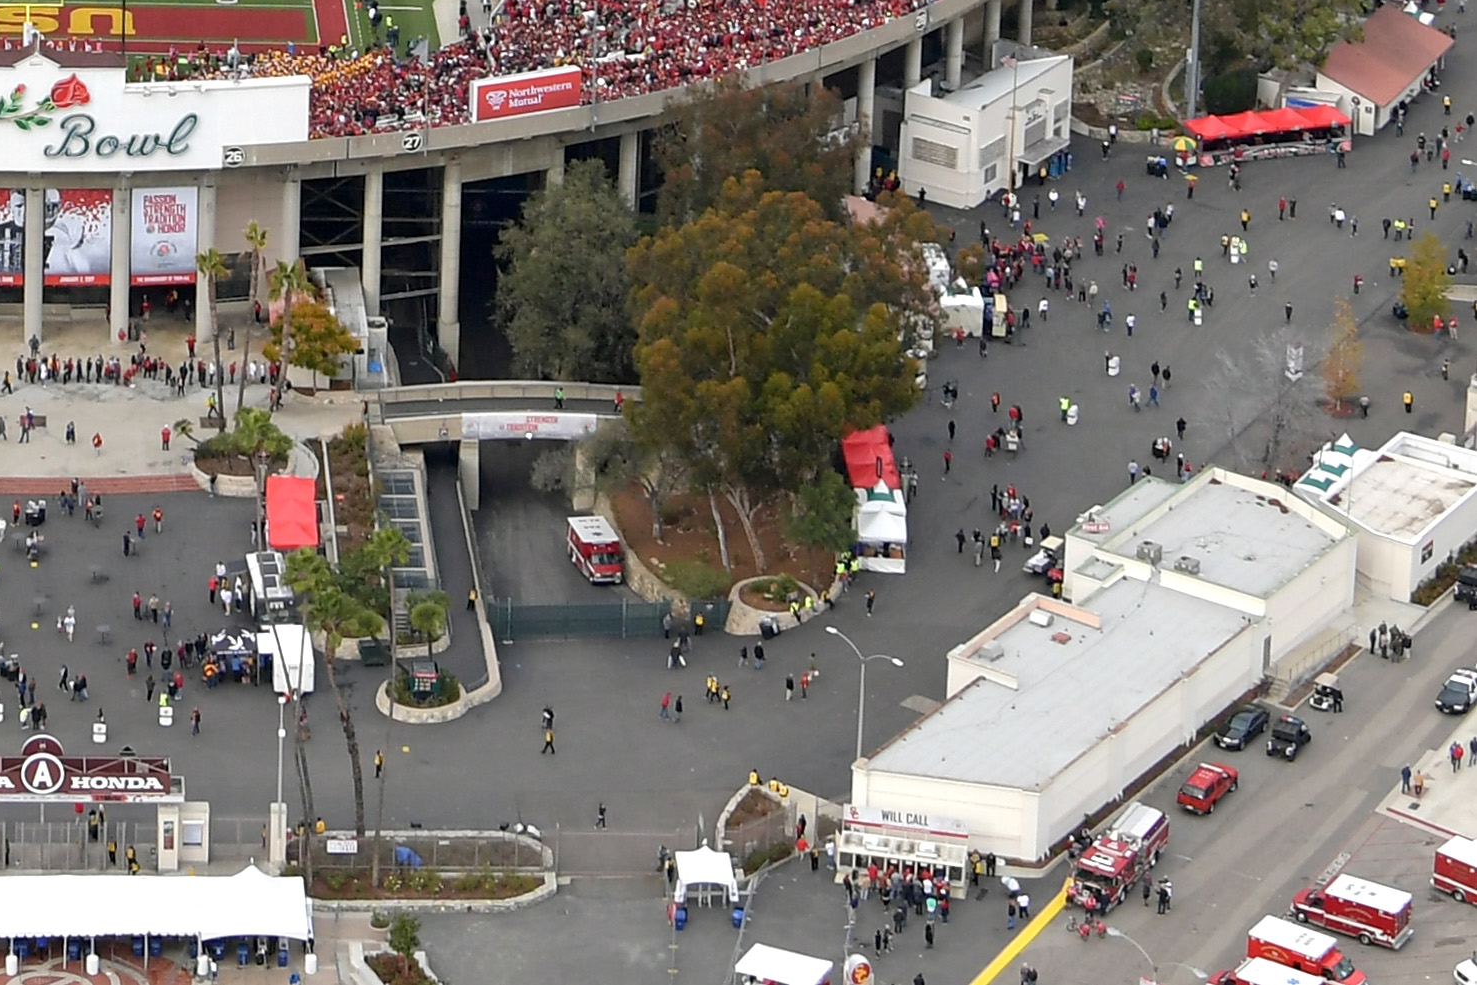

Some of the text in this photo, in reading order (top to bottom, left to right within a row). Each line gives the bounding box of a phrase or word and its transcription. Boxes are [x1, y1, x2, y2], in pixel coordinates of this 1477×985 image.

[508, 81, 573, 99] Northwestern
[508, 95, 543, 108] Mutual
[43, 112, 198, 159] Bowl
[405, 136, 420, 149] 27
[225, 150, 243, 162] 26
[143, 194, 177, 205] PASSION
[143, 204, 186, 215] STRENGTH
[144, 213, 186, 224] TRADITION
[157, 224, 186, 234] HONOR
[32, 760, 54, 788] A
[70, 776, 164, 789] HONDA
[881, 809, 929, 827] WILL CALL
